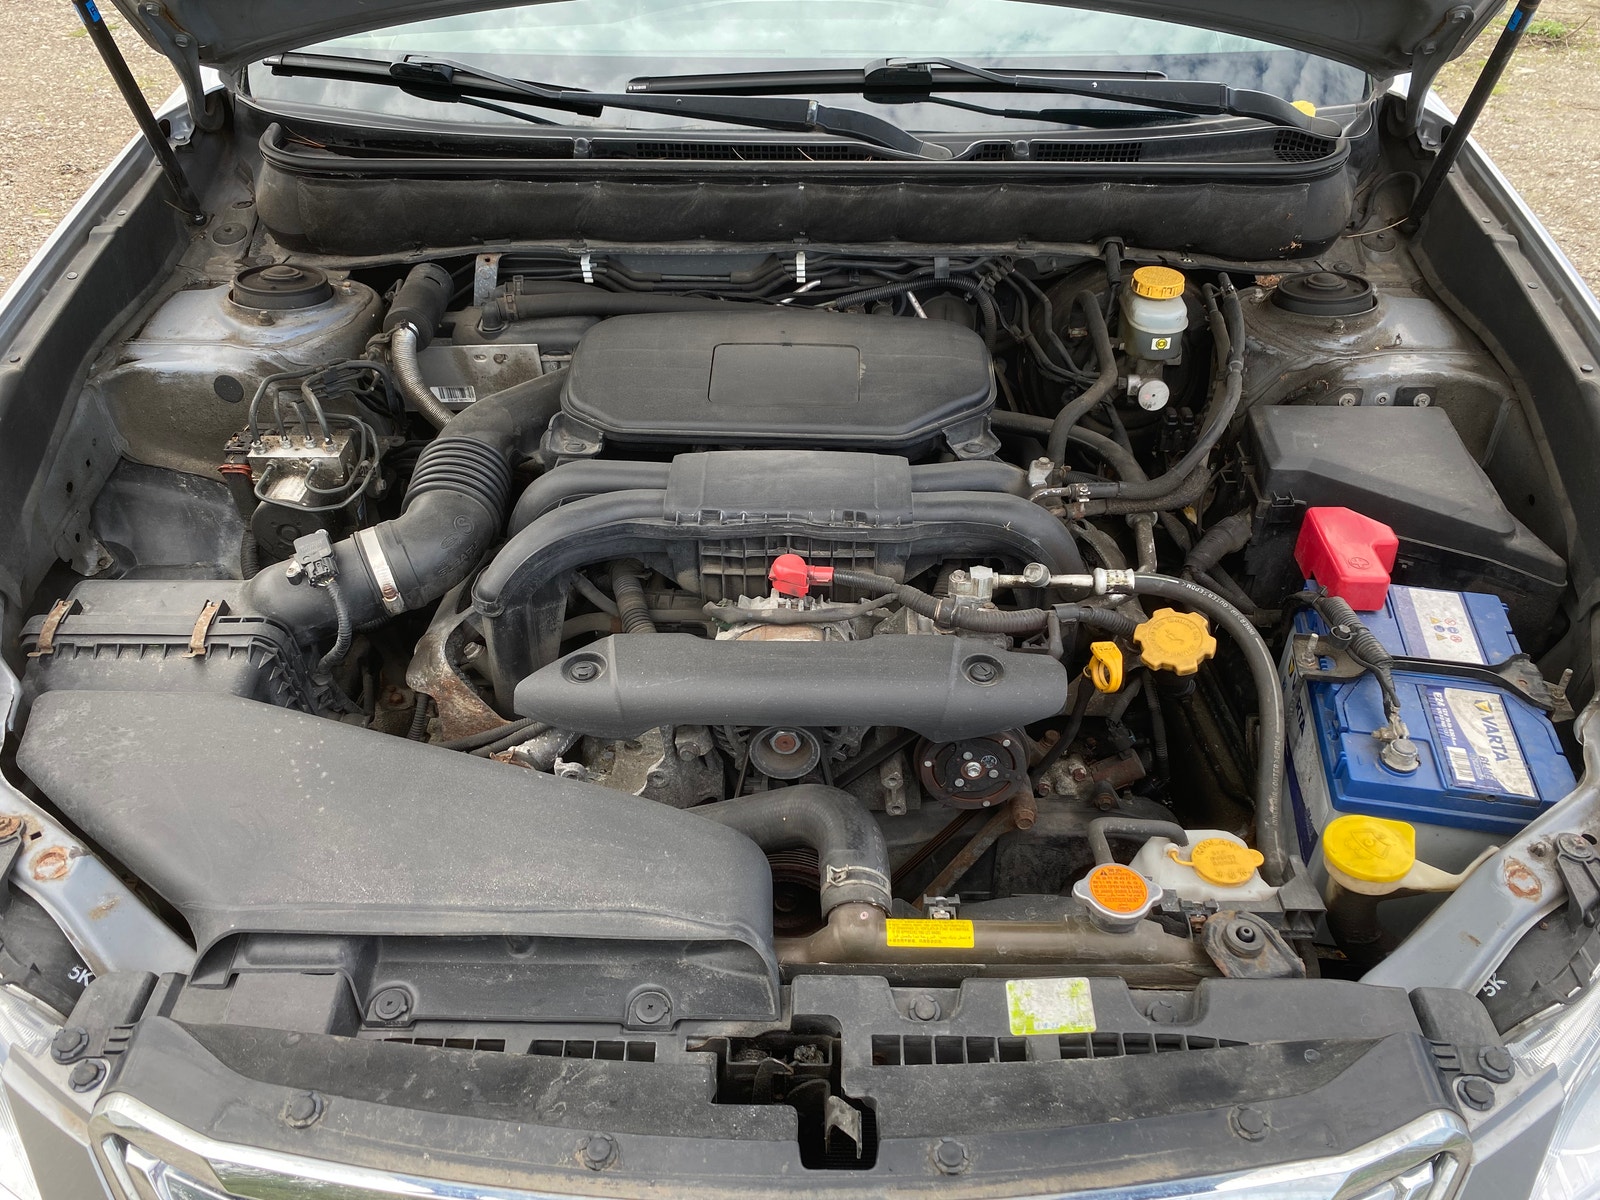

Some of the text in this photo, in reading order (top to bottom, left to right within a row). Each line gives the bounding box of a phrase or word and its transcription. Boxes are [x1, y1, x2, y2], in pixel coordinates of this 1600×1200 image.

[1481, 715, 1510, 762] VARTA
[1479, 755, 1498, 781] BLUE
[67, 965, 93, 987] 5K
[1482, 972, 1508, 997] 5K
